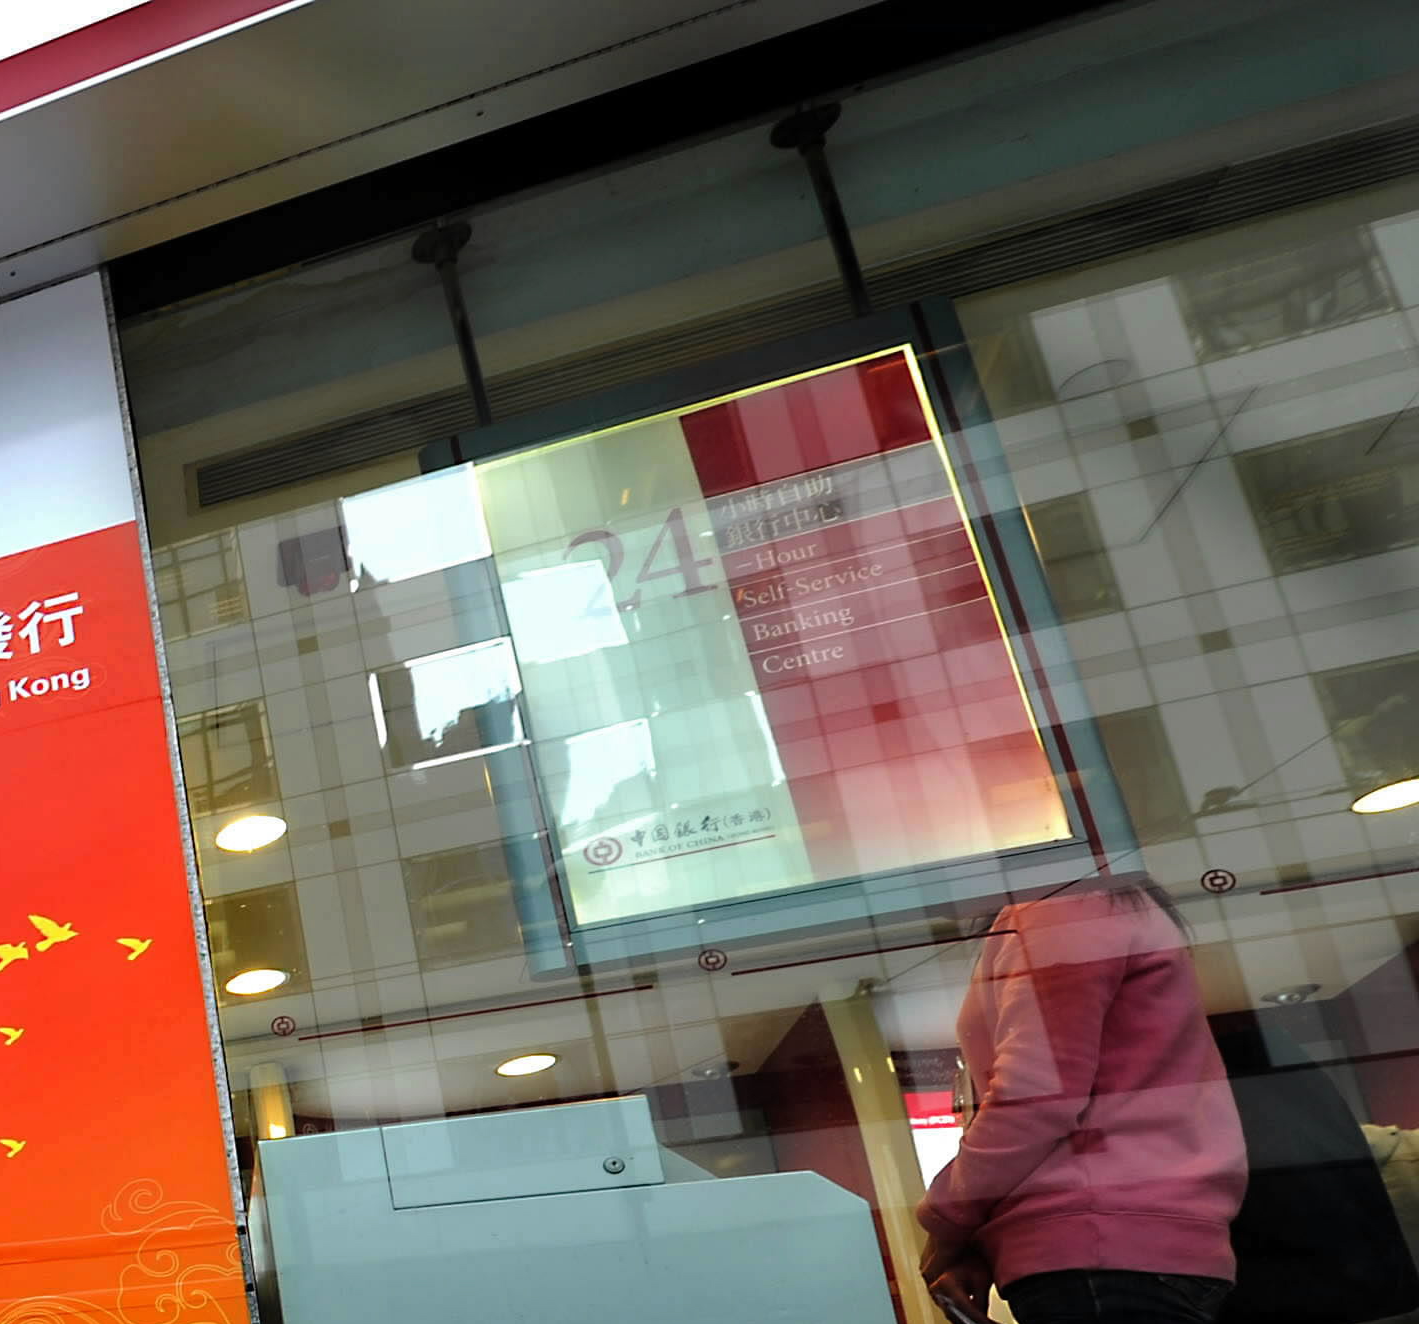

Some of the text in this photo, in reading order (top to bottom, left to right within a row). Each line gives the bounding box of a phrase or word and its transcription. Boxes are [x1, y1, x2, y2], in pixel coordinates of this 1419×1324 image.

[720, 474, 834, 521] 小時自助
[725, 502, 843, 548] 銀行中心
[565, 507, 718, 615] 24
[742, 561, 884, 608] Self-Service
[752, 602, 855, 642] Banking
[762, 643, 844, 675] Centre
[8, 667, 91, 702] Kong
